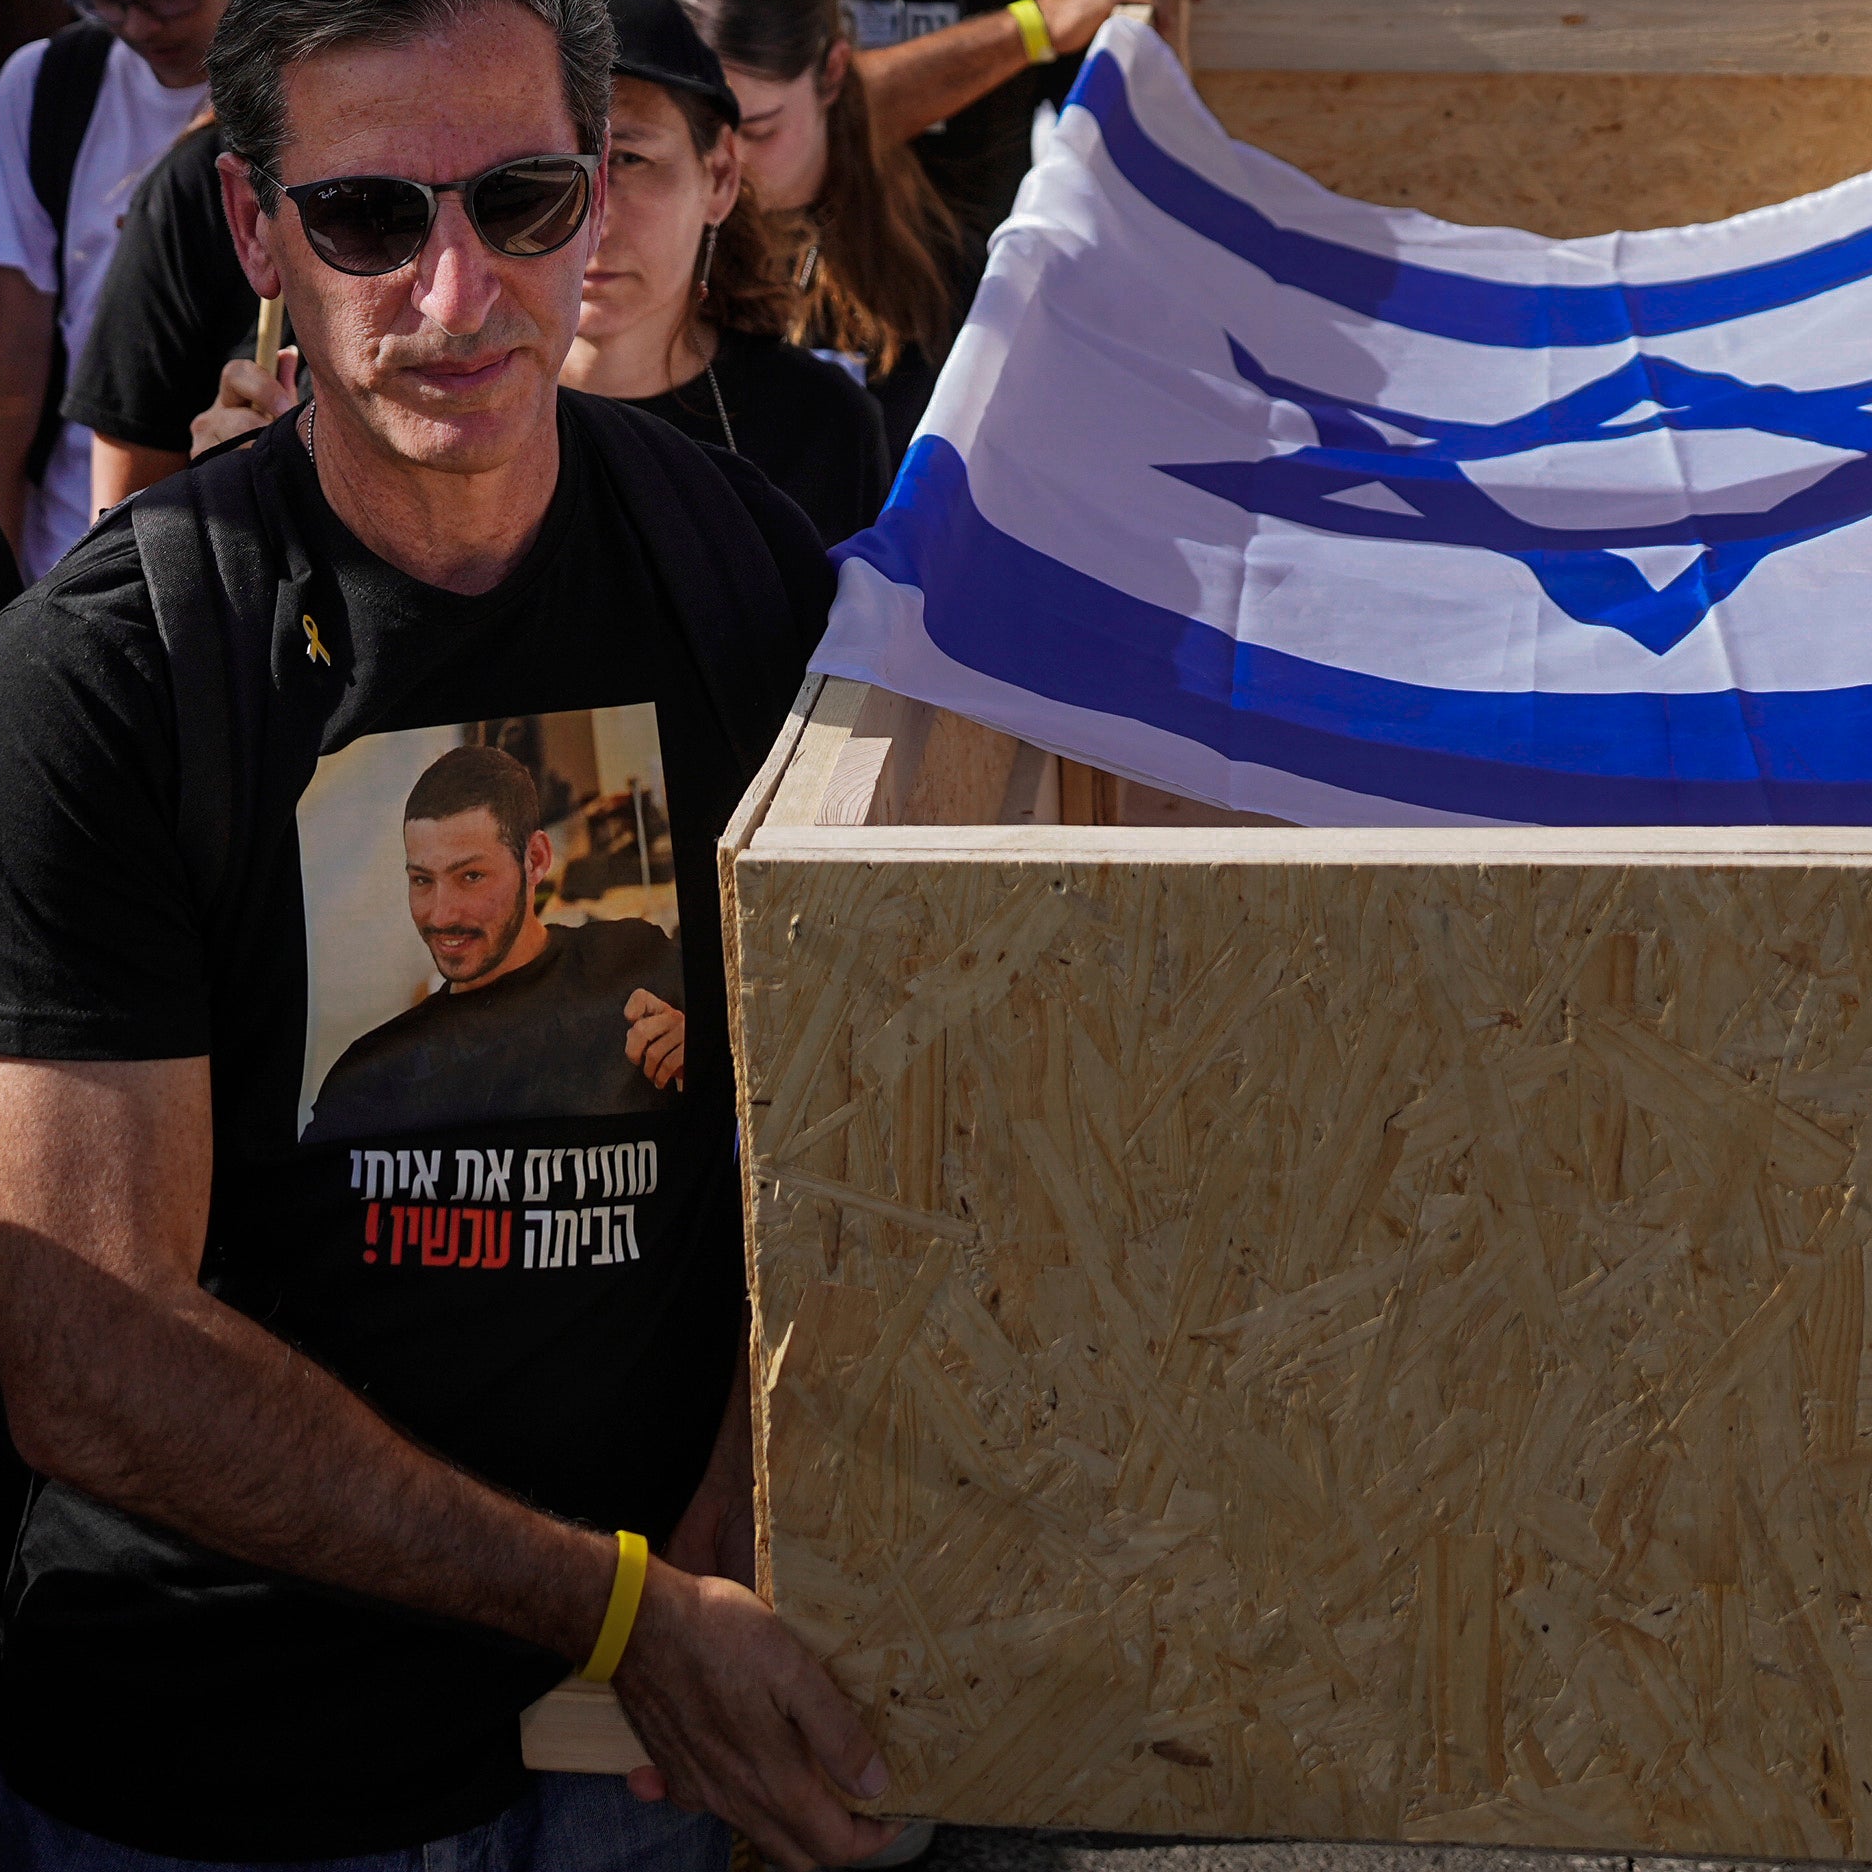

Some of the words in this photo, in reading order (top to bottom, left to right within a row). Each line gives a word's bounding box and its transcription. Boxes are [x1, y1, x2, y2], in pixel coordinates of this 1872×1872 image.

[349, 1148, 442, 1202] איתי
[449, 1148, 515, 1203] את
[522, 1140, 659, 1204] מחזירים
[362, 1202, 513, 1269] עכשיו!
[523, 1204, 641, 1269] הביתה
